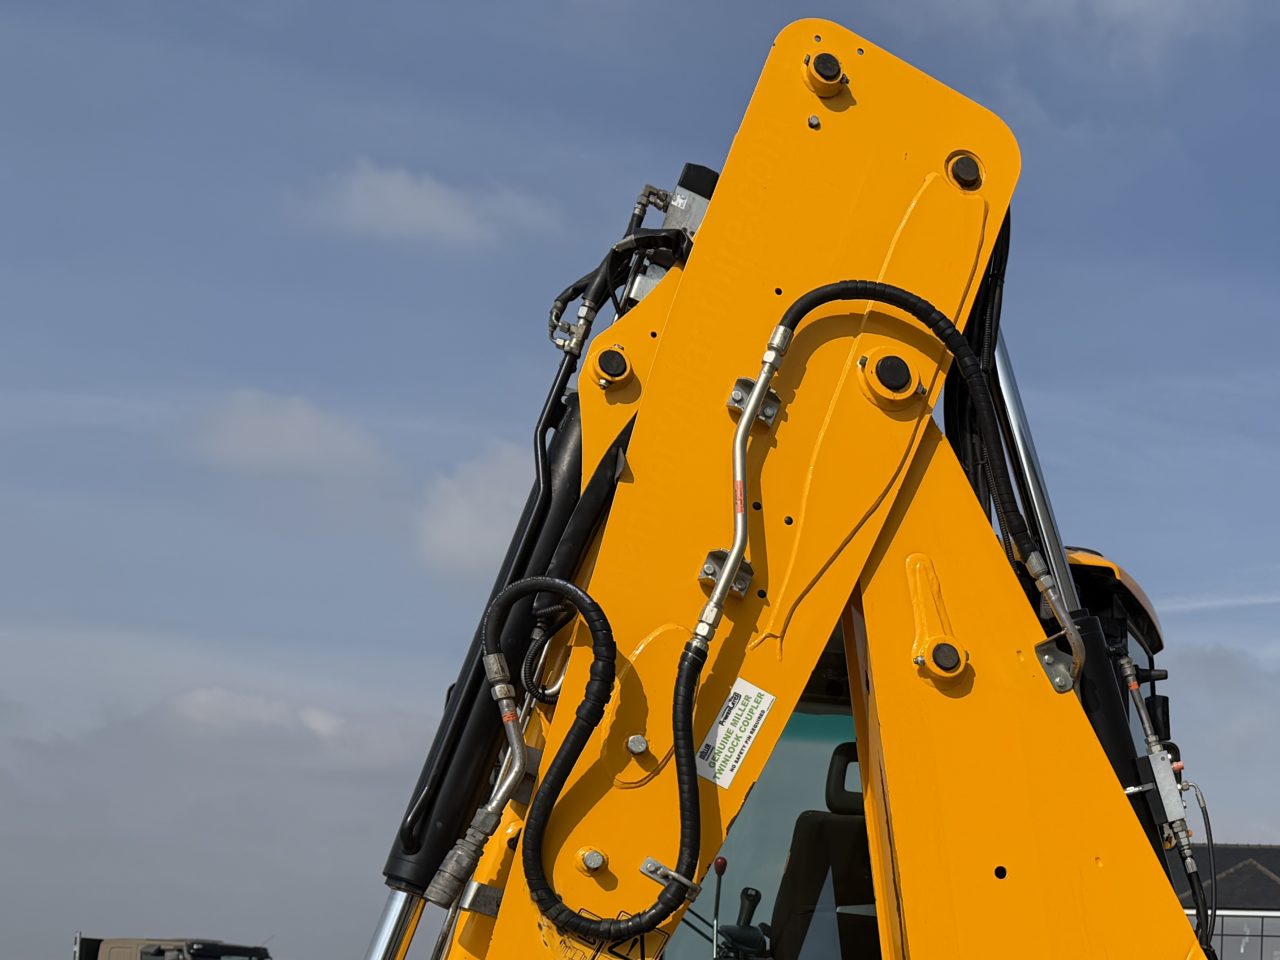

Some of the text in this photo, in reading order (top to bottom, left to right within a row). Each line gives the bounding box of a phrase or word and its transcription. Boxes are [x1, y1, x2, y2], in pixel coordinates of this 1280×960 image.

[708, 727, 734, 769] GENUINE
[730, 693, 752, 728] MILLER
[712, 691, 765, 780] TWINLOCK COUPLER
[729, 709, 766, 773] NO SAFETY PIN REQUIRED
